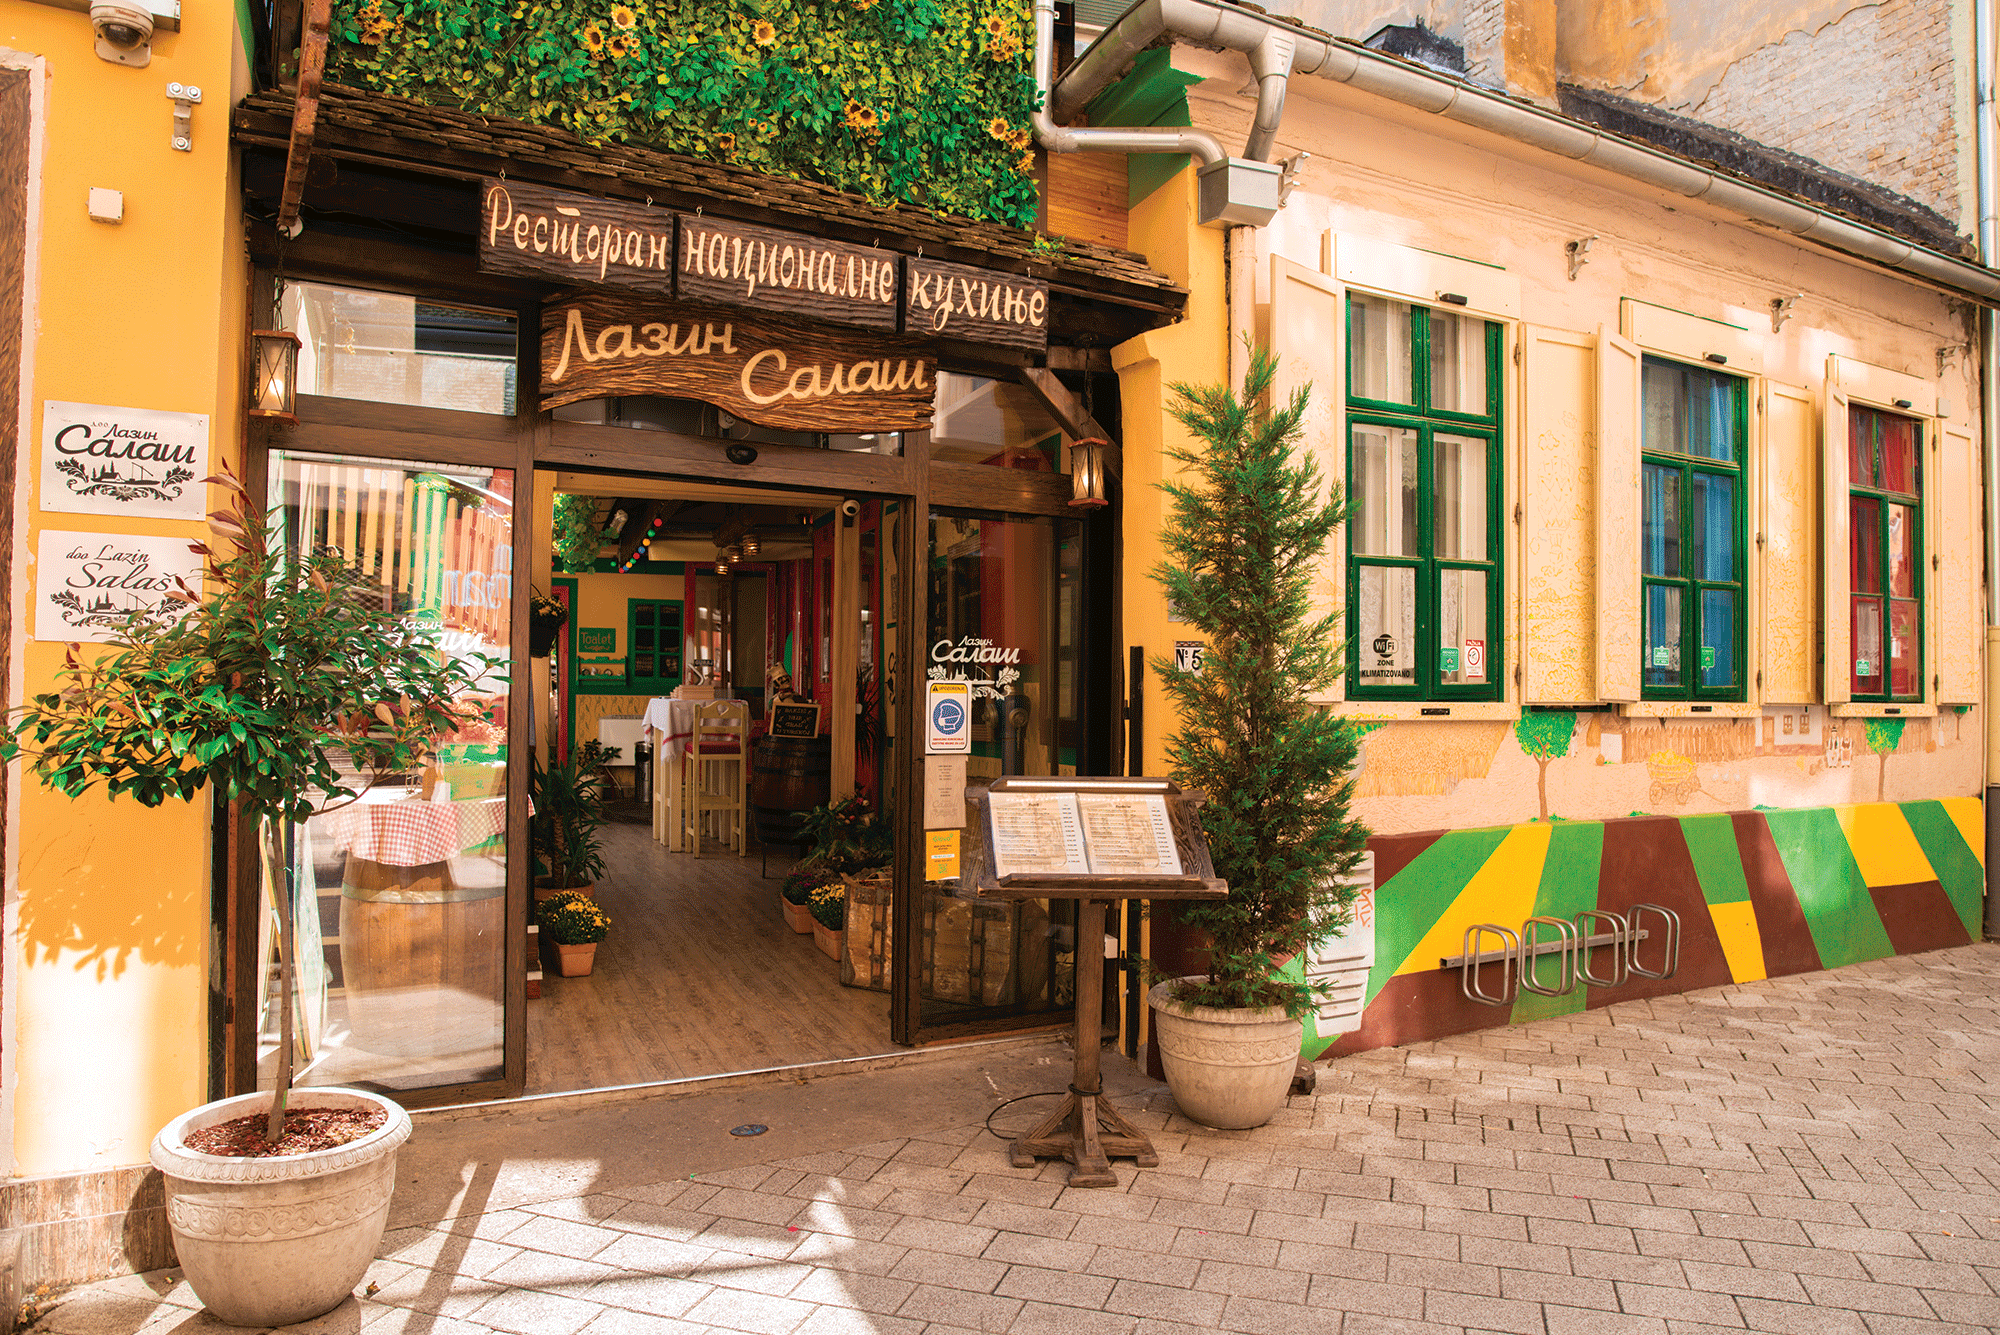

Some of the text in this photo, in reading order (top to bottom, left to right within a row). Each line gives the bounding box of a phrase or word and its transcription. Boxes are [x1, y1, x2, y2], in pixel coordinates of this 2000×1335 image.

[487, 187, 1046, 331] Ресторан националне кухиње
[550, 309, 738, 381] Лазин
[741, 349, 928, 404] Салаш
[55, 424, 196, 464] Салаш
[103, 424, 158, 441] Лазин
[66, 544, 150, 565] doo Lazin
[65, 562, 178, 591] Salaš
[581, 632, 612, 645] Toalet
[958, 635, 993, 647] Лазин
[931, 640, 1020, 664] Салаш
[1361, 669, 1411, 678] KLIMATIZOVANO
